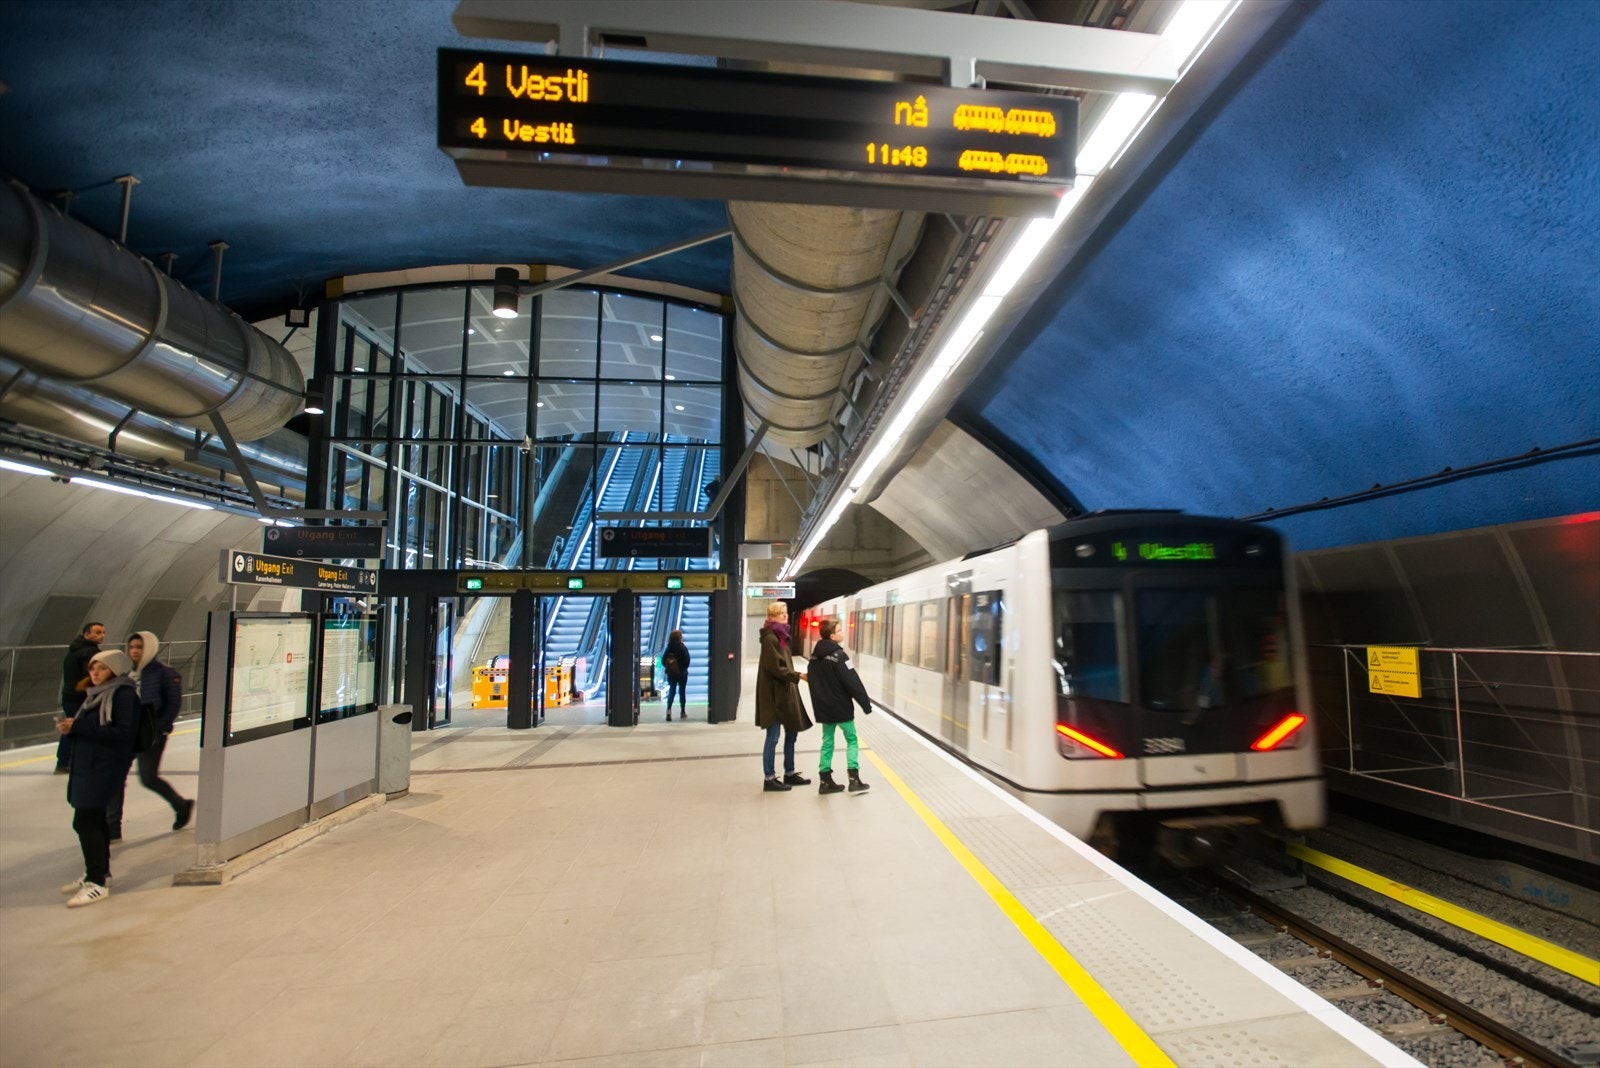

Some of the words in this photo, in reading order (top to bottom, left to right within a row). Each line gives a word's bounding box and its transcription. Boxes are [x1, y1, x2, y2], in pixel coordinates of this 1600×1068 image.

[465, 62, 487, 95] 4
[506, 64, 589, 103] Vestli
[895, 95, 929, 128] nå
[470, 117, 487, 139] 4
[503, 118, 576, 144] Vestli
[866, 142, 928, 168] 11:48
[255, 559, 281, 576] Utgang
[281, 562, 294, 575] Exit
[318, 567, 338, 582] Utgang
[338, 569, 348, 580] Exit
